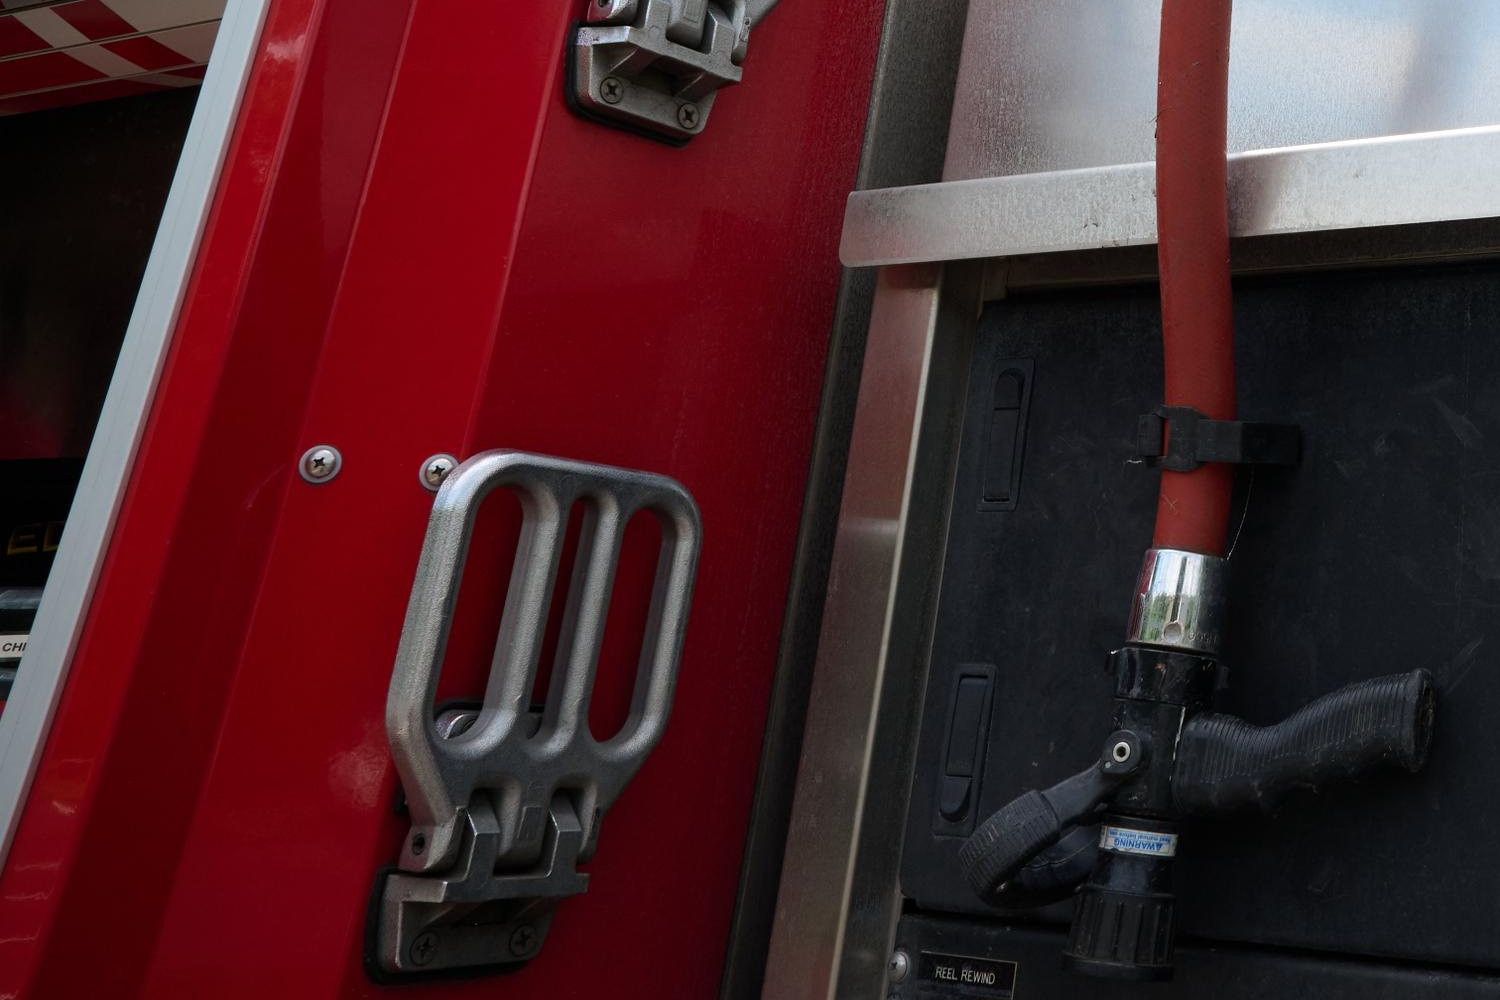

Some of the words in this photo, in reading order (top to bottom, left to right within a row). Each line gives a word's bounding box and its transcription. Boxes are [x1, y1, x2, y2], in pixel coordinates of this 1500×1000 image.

[1114, 837, 1157, 851] WARNING
[935, 966, 957, 981] REEL
[960, 969, 996, 985] REWIND
